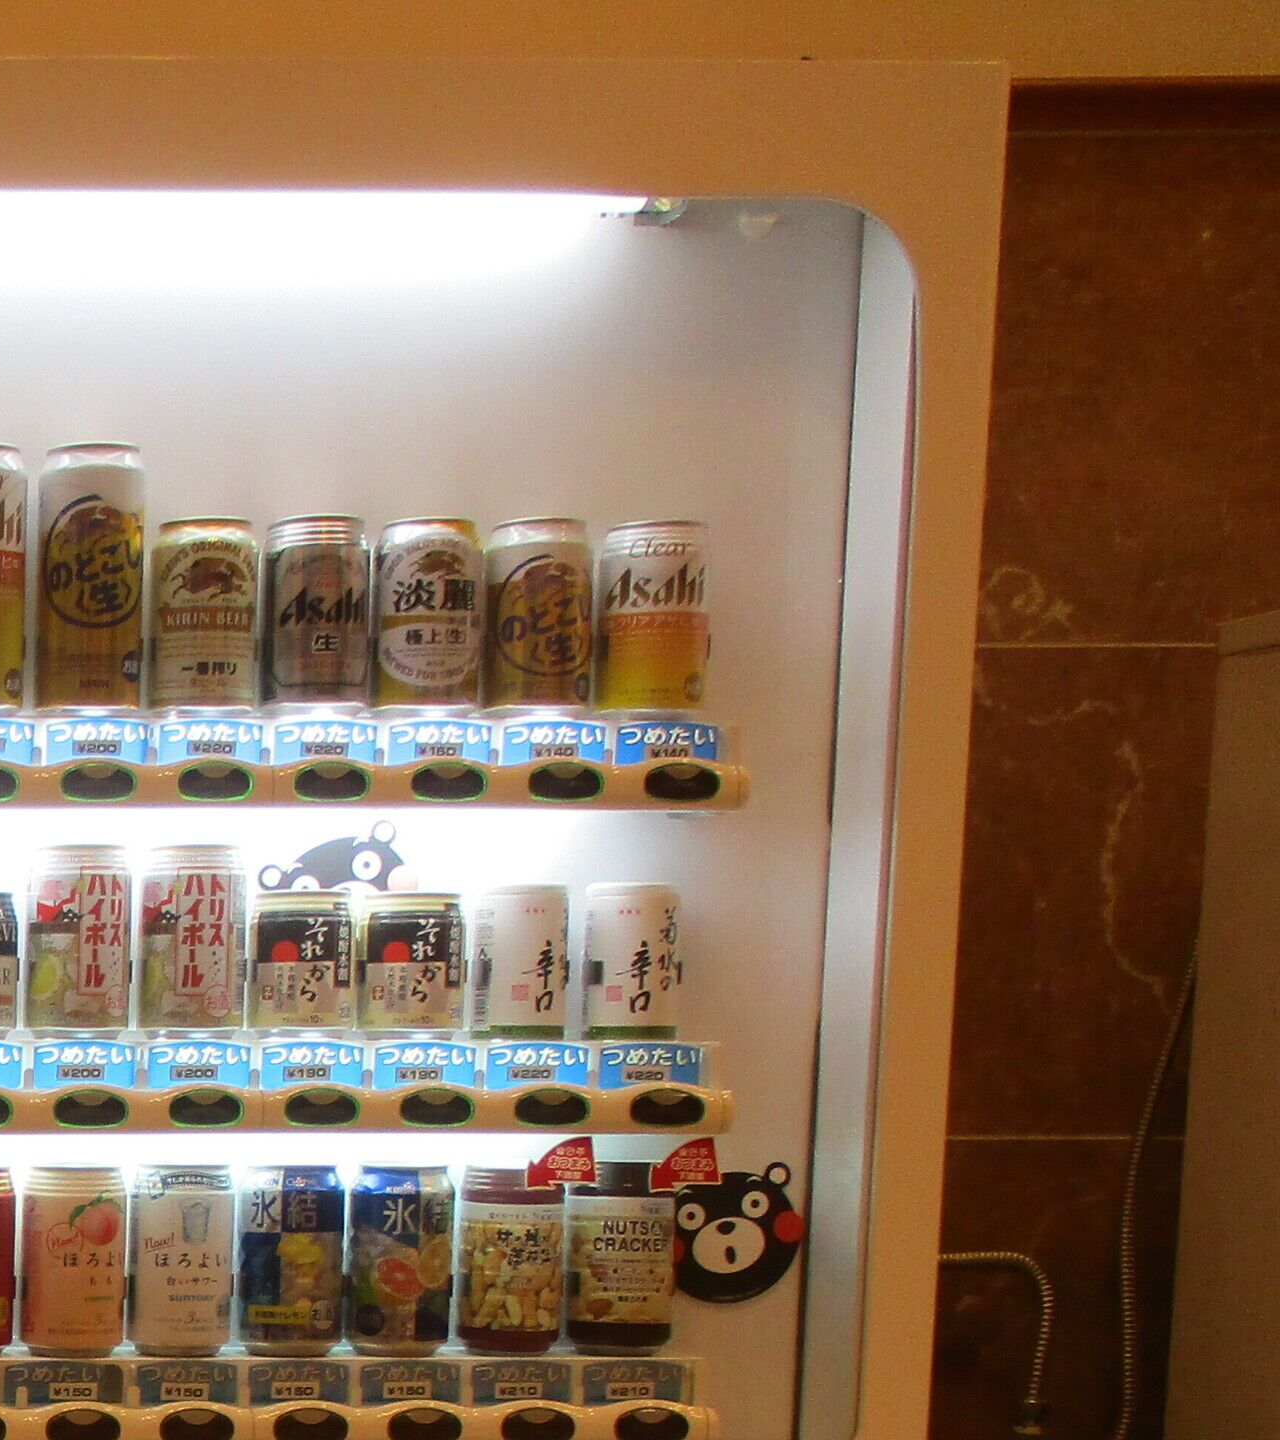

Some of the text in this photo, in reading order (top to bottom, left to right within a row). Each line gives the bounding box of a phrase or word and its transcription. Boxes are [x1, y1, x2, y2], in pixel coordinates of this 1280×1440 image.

[628, 536, 693, 559] Clear
[392, 578, 476, 614] 淡麗
[605, 562, 706, 612] Asahi
[278, 586, 369, 628] Asahi
[166, 611, 210, 627] KIRIN
[311, 632, 340, 654] 生
[180, 660, 238, 677] 一番搾り
[46, 721, 147, 745] つめたい
[161, 723, 263, 745] つめたい
[276, 723, 377, 745] つめたい
[390, 724, 490, 745] つめたい
[503, 725, 605, 746] つめたい
[617, 726, 716, 746] つめたい
[75, 743, 118, 755] ¥200
[191, 744, 233, 755] ¥220
[303, 744, 345, 755] ¥220
[208, 873, 226, 947] トリス
[83, 874, 108, 989] ハイボール
[181, 874, 206, 989] ハイボール
[300, 916, 332, 1003] それから
[410, 916, 445, 1003] それから
[35, 1046, 136, 1066] つめたい
[148, 1046, 249, 1066] つめたい
[262, 1047, 361, 1067] つめたい
[376, 1047, 476, 1067] つめたい
[489, 1047, 589, 1067] つめたい
[602, 1047, 700, 1068] つめたい
[173, 1067, 214, 1079] ¥200
[510, 1068, 551, 1080] ¥220
[625, 1070, 665, 1081] ¥220
[250, 1190, 318, 1229] 氷結
[602, 1220, 649, 1236] NUTS
[154, 1252, 228, 1269] ほろよい
[8, 1365, 103, 1383] つめたい
[139, 1364, 238, 1384] つめたい
[251, 1364, 347, 1384] つめたい
[363, 1364, 458, 1384] つめたい
[474, 1364, 570, 1384] つめたい
[585, 1364, 683, 1384] つめたい
[52, 1387, 93, 1398] ¥150
[163, 1386, 204, 1398] ¥150
[499, 1385, 539, 1397] ¥210
[609, 1385, 650, 1397] ¥210
